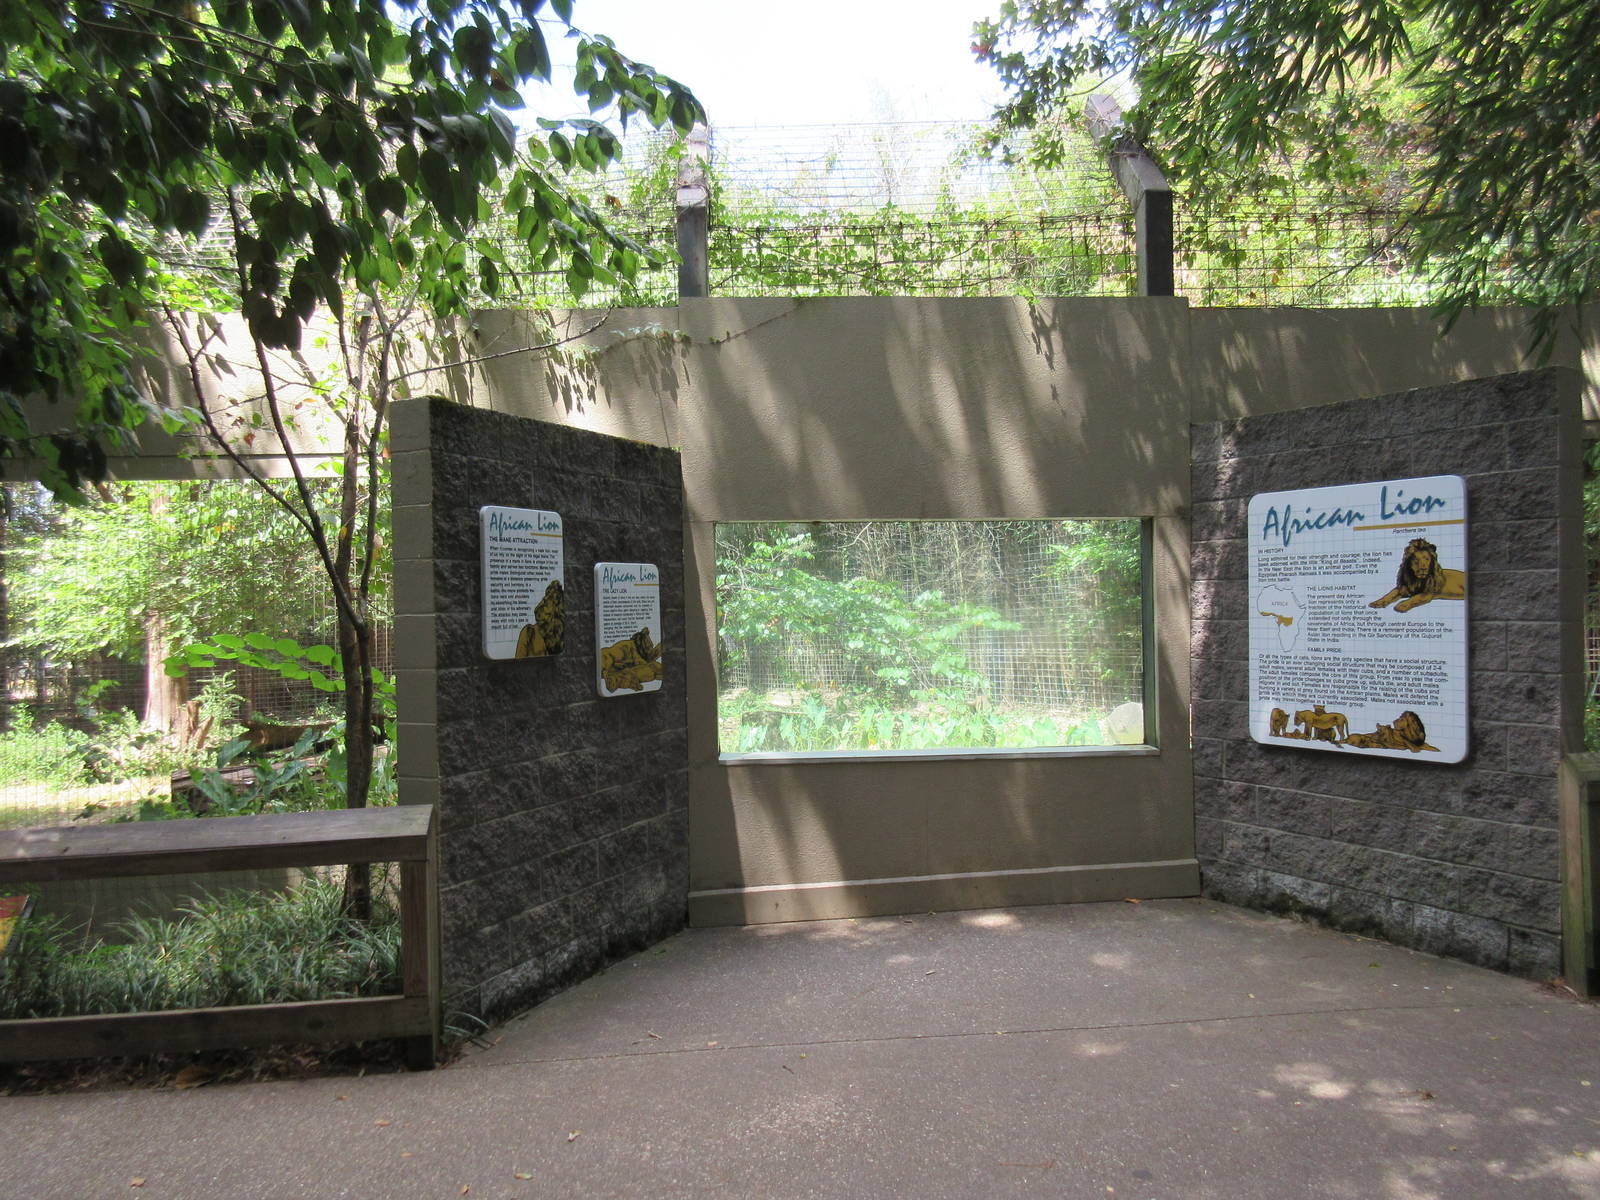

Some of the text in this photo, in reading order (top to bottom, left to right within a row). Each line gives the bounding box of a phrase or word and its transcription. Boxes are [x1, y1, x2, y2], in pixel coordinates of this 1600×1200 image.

[489, 511, 560, 536] African Lion
[1263, 486, 1445, 547] African Lion
[603, 565, 656, 590] African Lion
